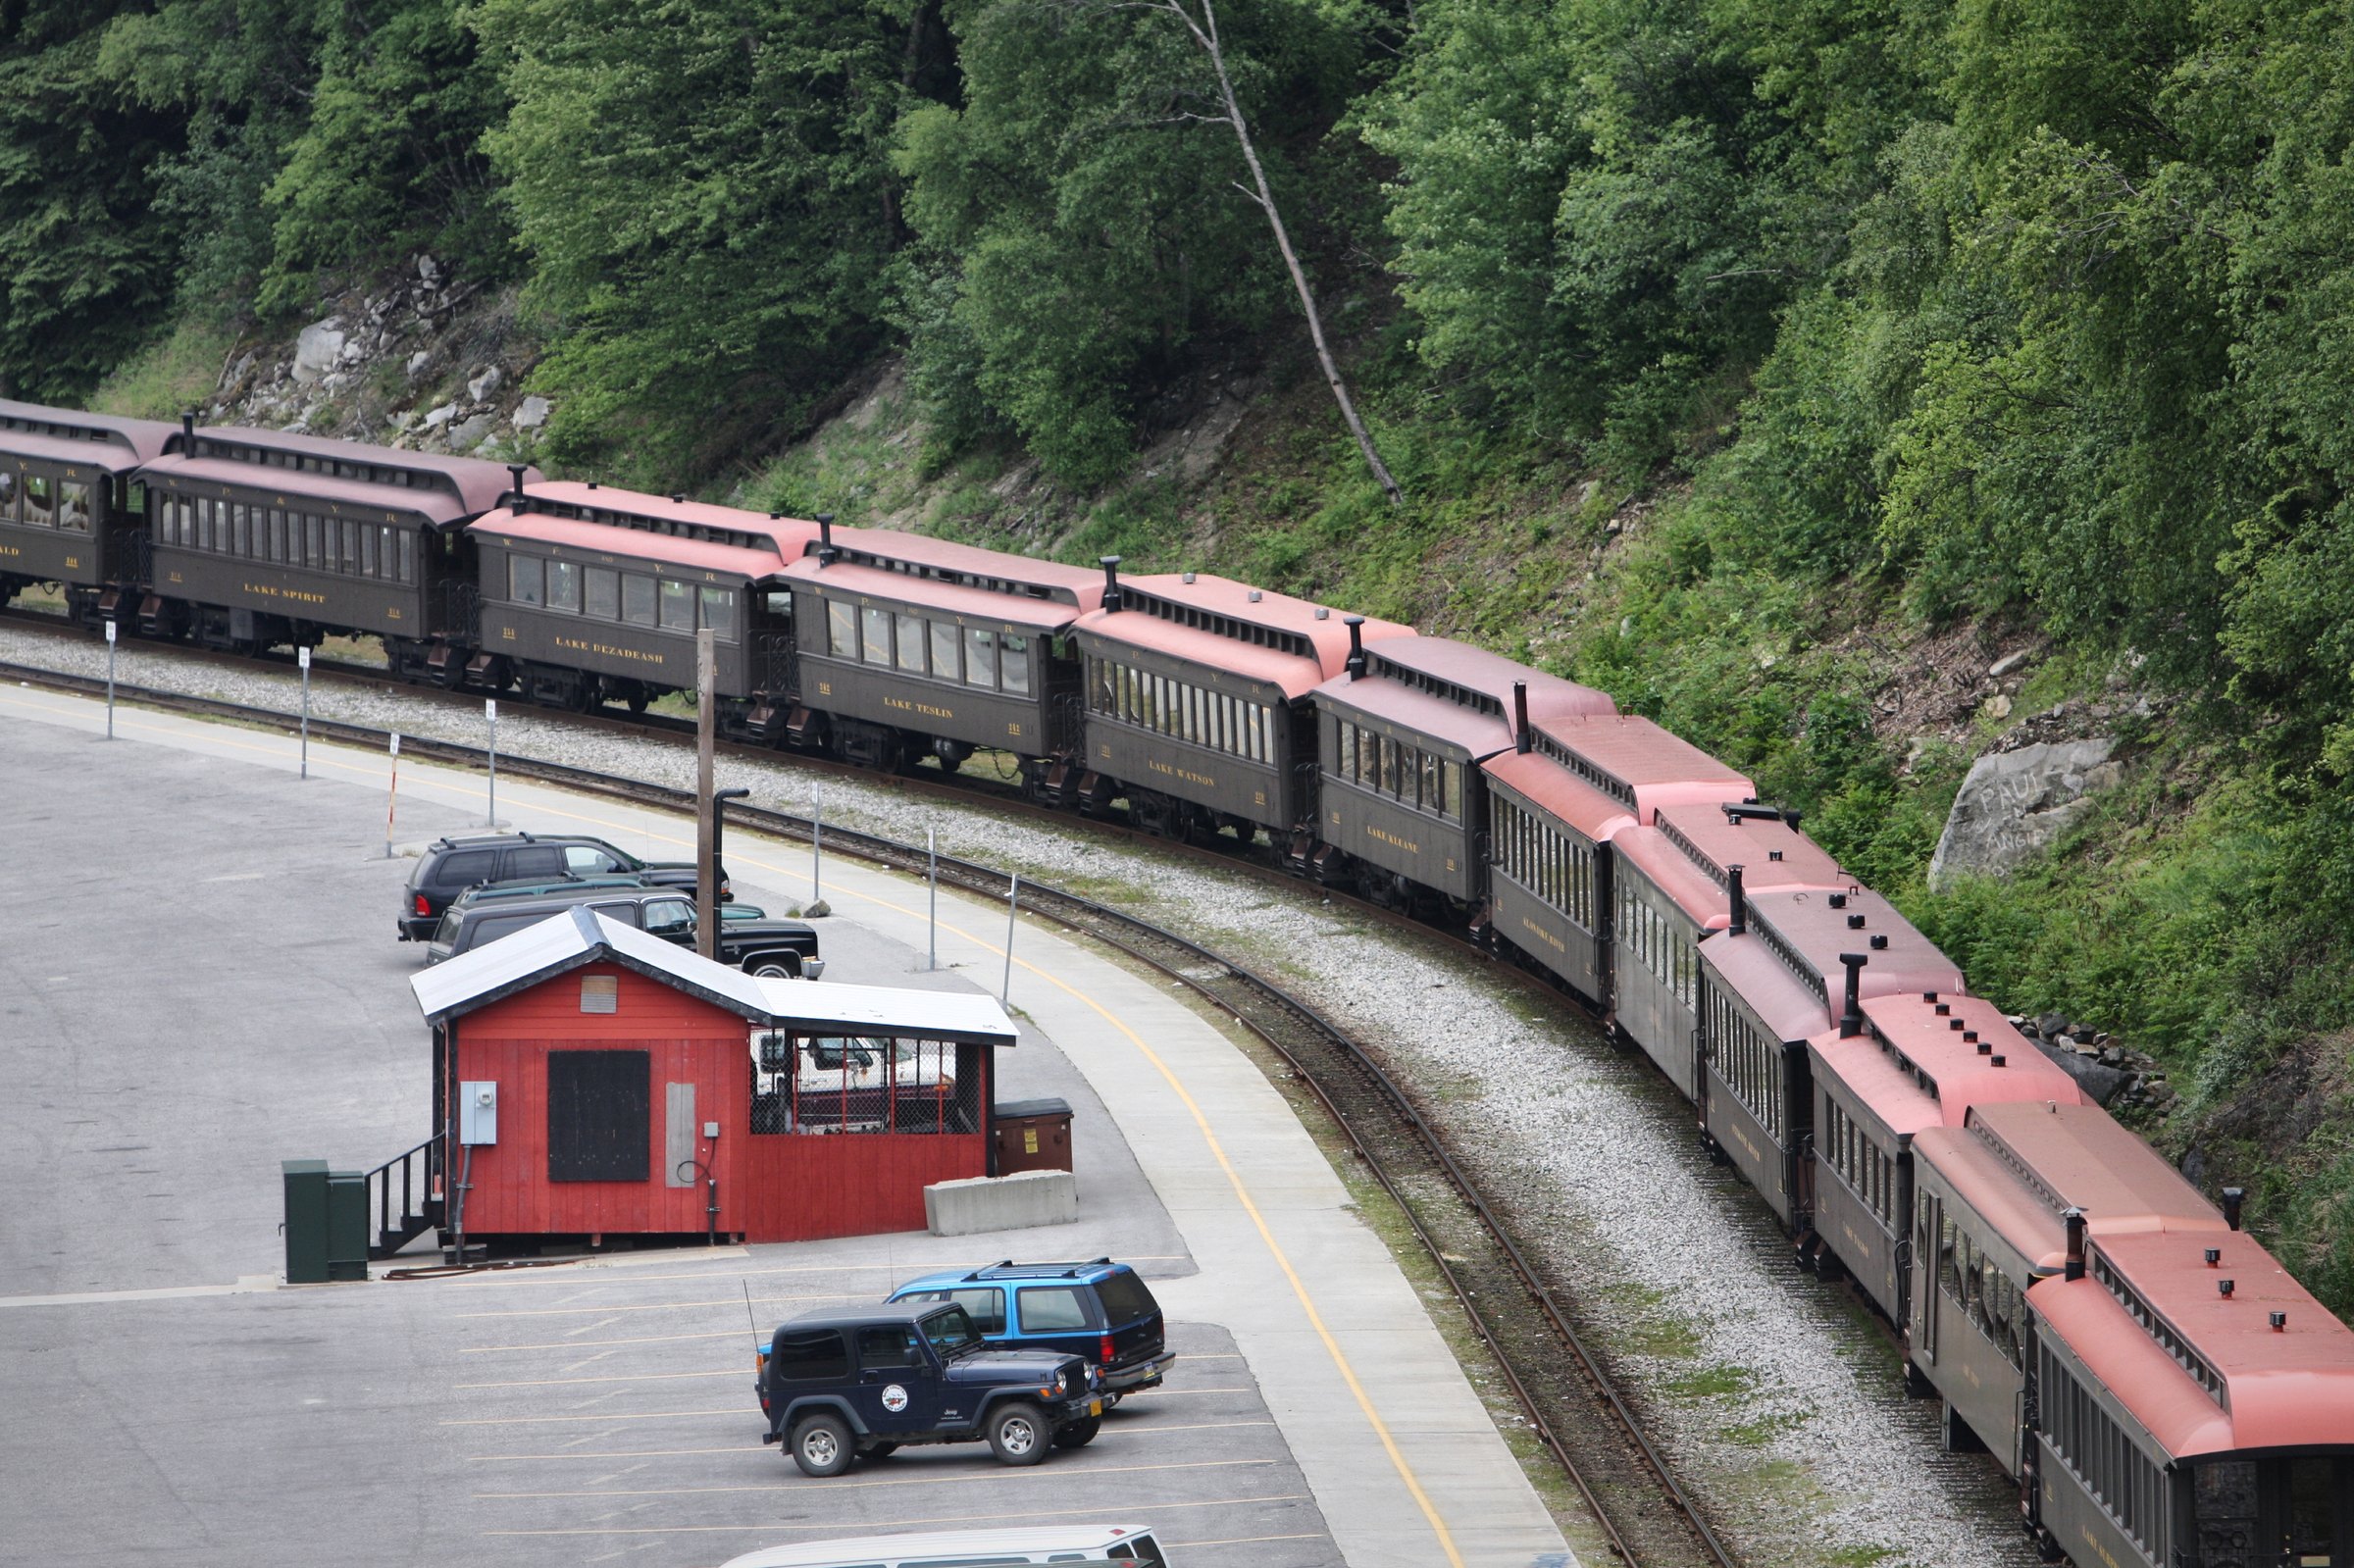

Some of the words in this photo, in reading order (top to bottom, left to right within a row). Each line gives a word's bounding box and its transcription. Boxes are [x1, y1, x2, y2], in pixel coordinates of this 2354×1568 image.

[244, 582, 279, 597] LAKE
[282, 589, 326, 603] SPIRIT
[555, 636, 588, 651] LAKE
[593, 643, 663, 664] DEZADEASH
[885, 697, 912, 710] LAKE
[916, 703, 952, 718] TESLIN
[1149, 760, 1174, 775] LAKE
[1176, 769, 1214, 786] WATSON
[1979, 772, 2045, 813] PAUL
[1367, 825, 1386, 840] LAKE
[1986, 830, 2045, 849] ANGIE
